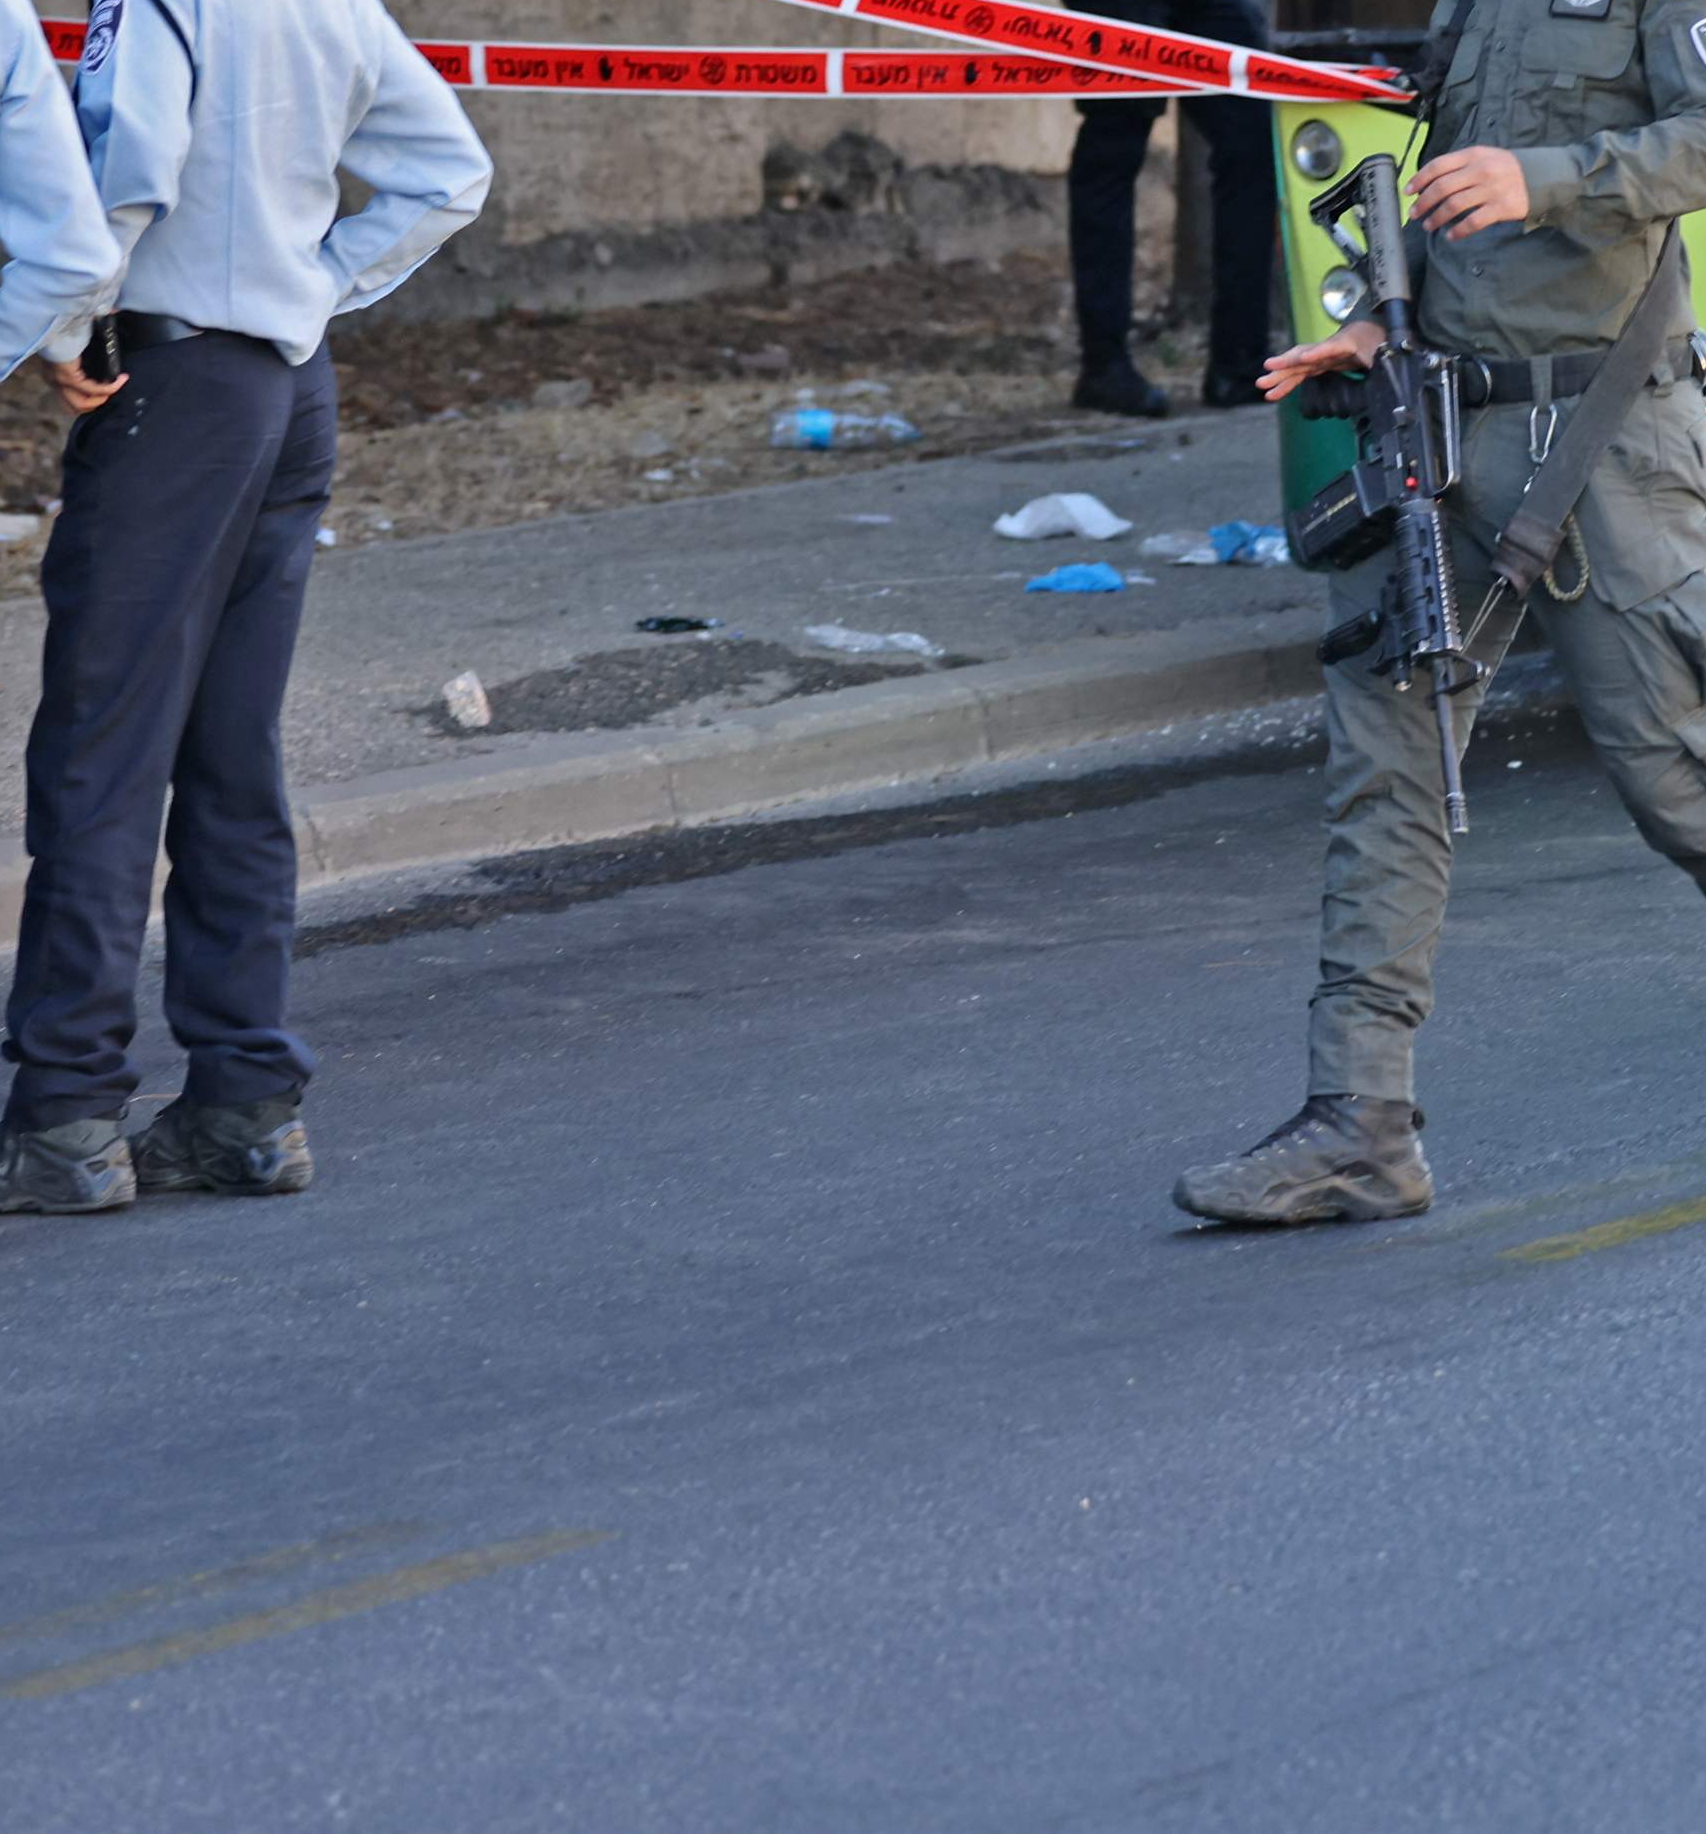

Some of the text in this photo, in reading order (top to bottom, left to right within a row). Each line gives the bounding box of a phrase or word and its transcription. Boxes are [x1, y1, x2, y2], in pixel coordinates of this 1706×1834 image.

[1001, 13, 1075, 53] ישראל
[1117, 35, 1152, 64] אין
[1151, 45, 1222, 76] מעבר
[493, 55, 820, 85] משטרת ישראל אין מעבר
[852, 60, 1064, 89] ישראל אין מעבר
